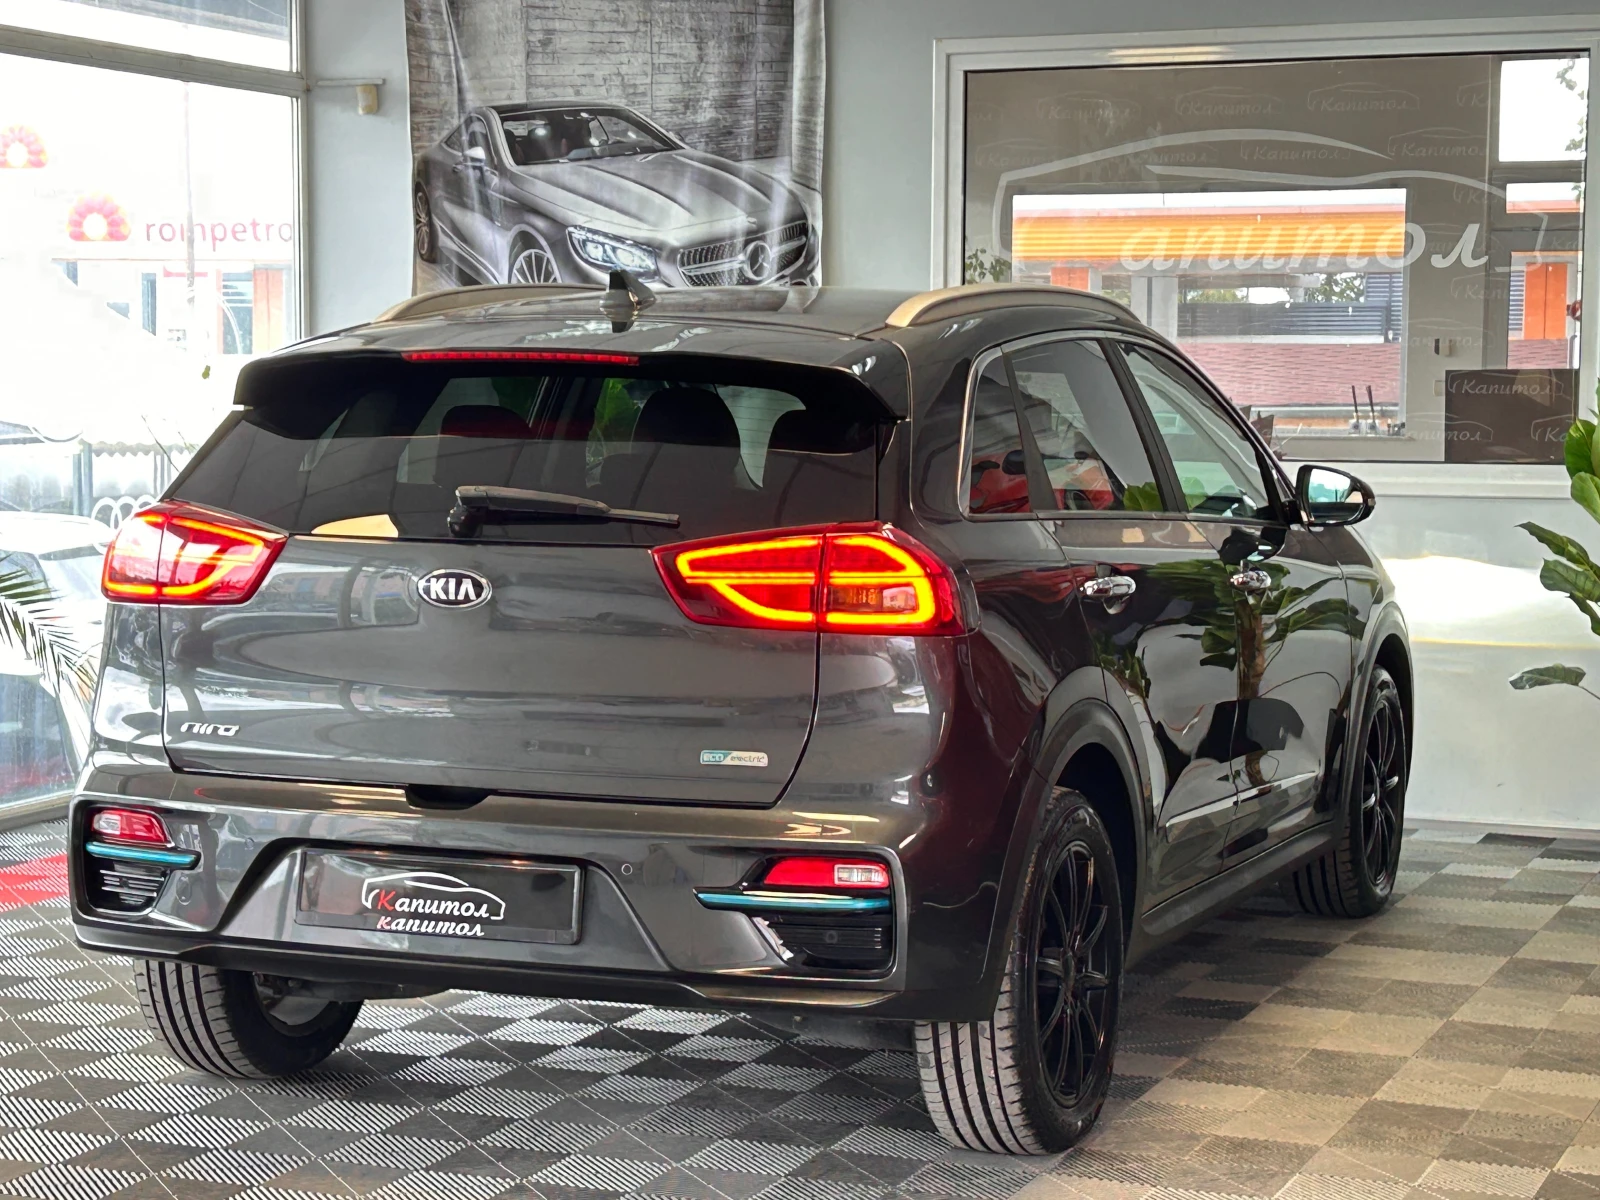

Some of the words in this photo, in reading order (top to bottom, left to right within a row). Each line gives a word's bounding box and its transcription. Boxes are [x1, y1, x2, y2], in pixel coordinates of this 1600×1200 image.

[1320, 96, 1410, 112] Капитол
[1252, 145, 1344, 161] Капитол
[1119, 222, 1489, 272] апитол
[1461, 379, 1554, 395] Капитол
[429, 577, 477, 601] KIA
[180, 722, 240, 737] niro
[377, 889, 490, 918] Капитол
